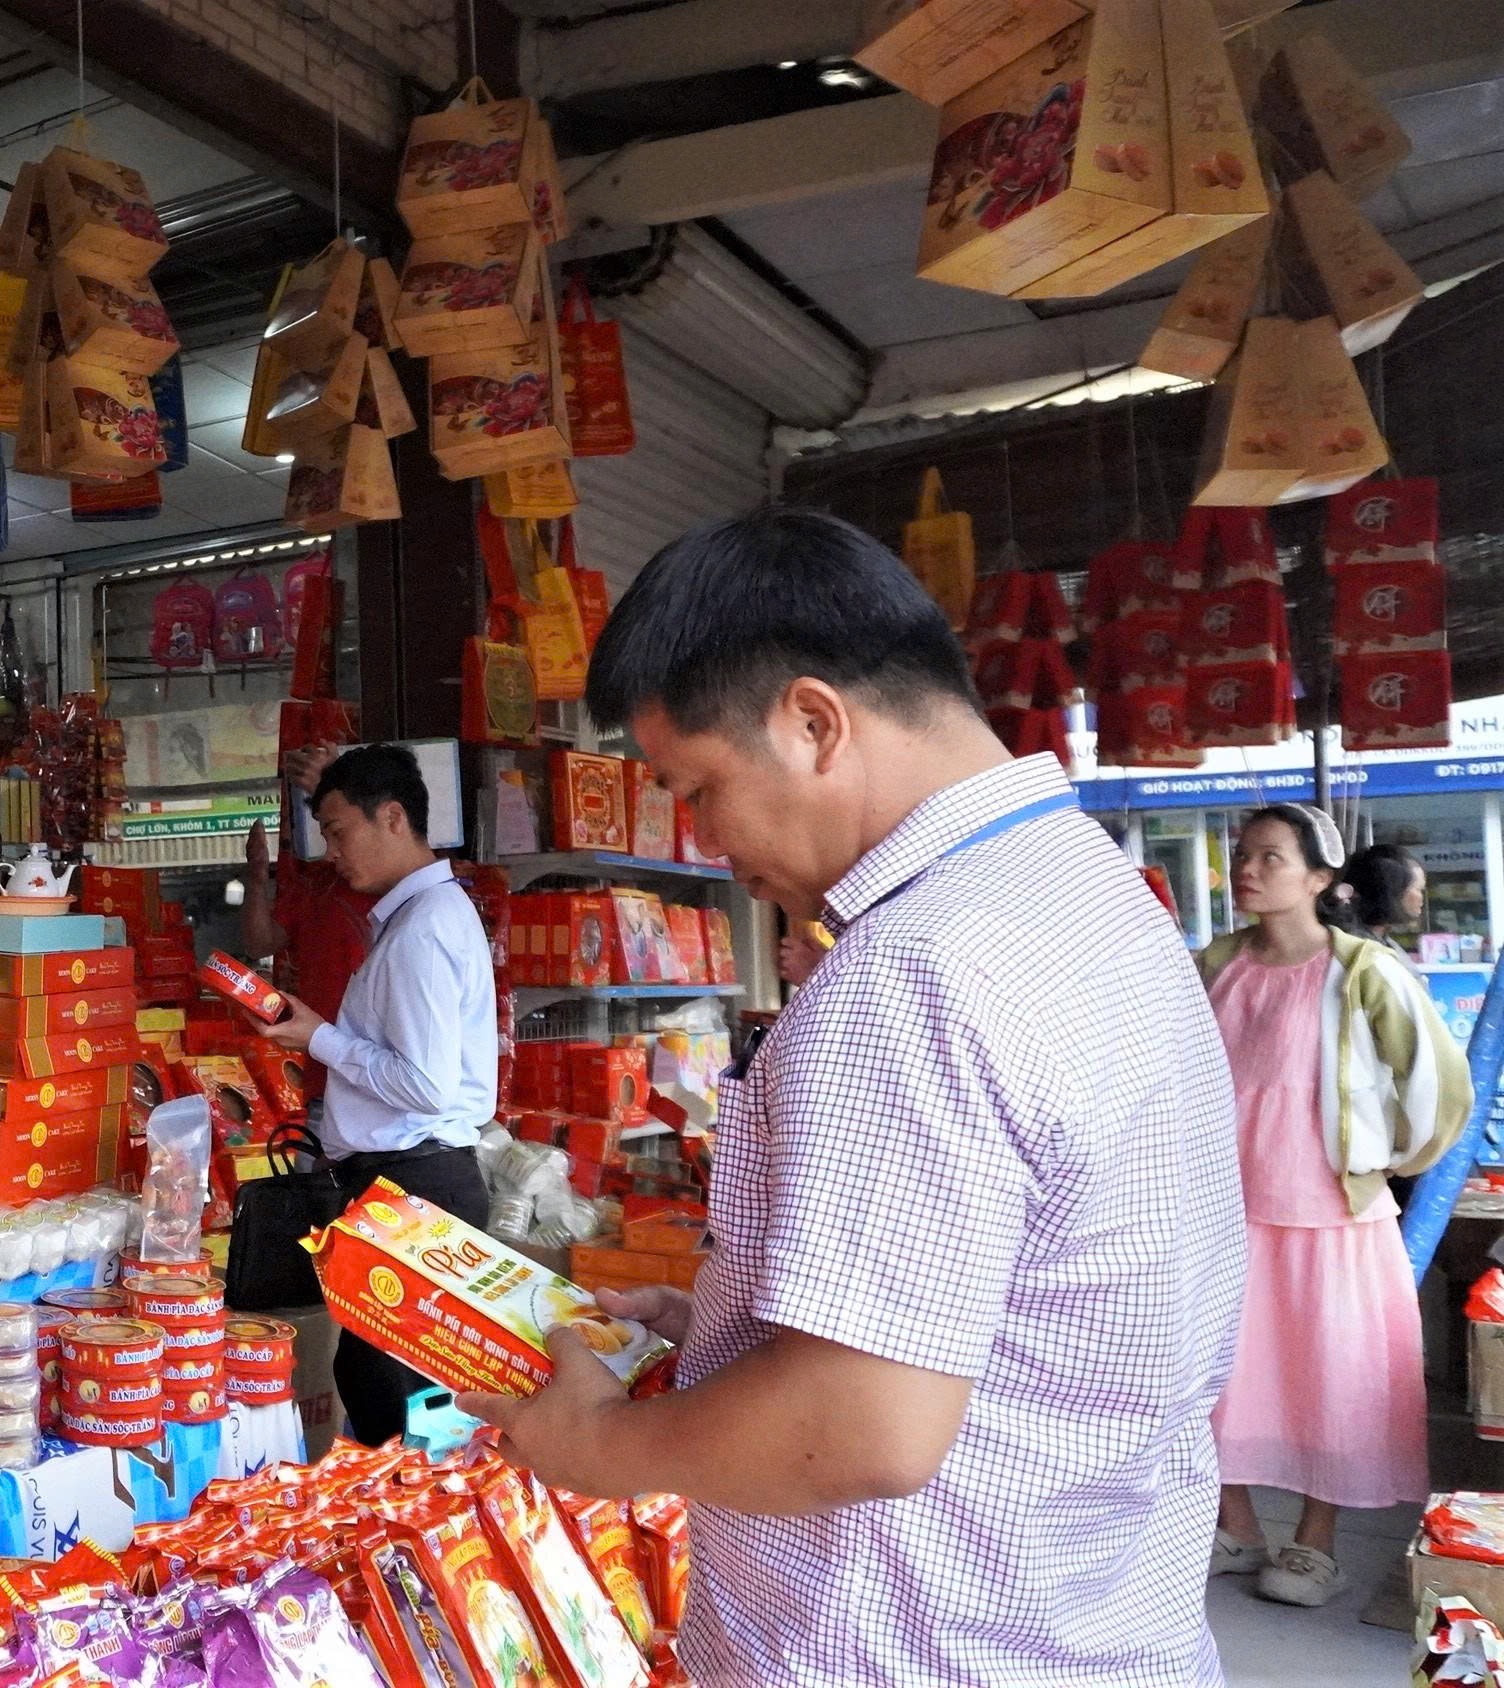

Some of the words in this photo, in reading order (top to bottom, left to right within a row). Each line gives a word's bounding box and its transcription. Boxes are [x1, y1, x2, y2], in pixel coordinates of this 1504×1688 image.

[126, 826, 146, 835] CHỢ
[173, 820, 203, 832] KHÓM
[219, 820, 229, 828] TT
[146, 1300, 169, 1313] BÁNH
[171, 1302, 188, 1315] PÍA
[188, 1301, 206, 1316] ĐẶC
[115, 1350, 139, 1364] BÁNH
[237, 1350, 254, 1361] CAO
[483, 1338, 510, 1362] XANH
[182, 1368, 199, 1380] CAO
[244, 1380, 260, 1392] SÓC
[110, 1389, 135, 1402] BÁNH
[92, 1418, 111, 1433] SẢN
[112, 1421, 129, 1433] SÓC
